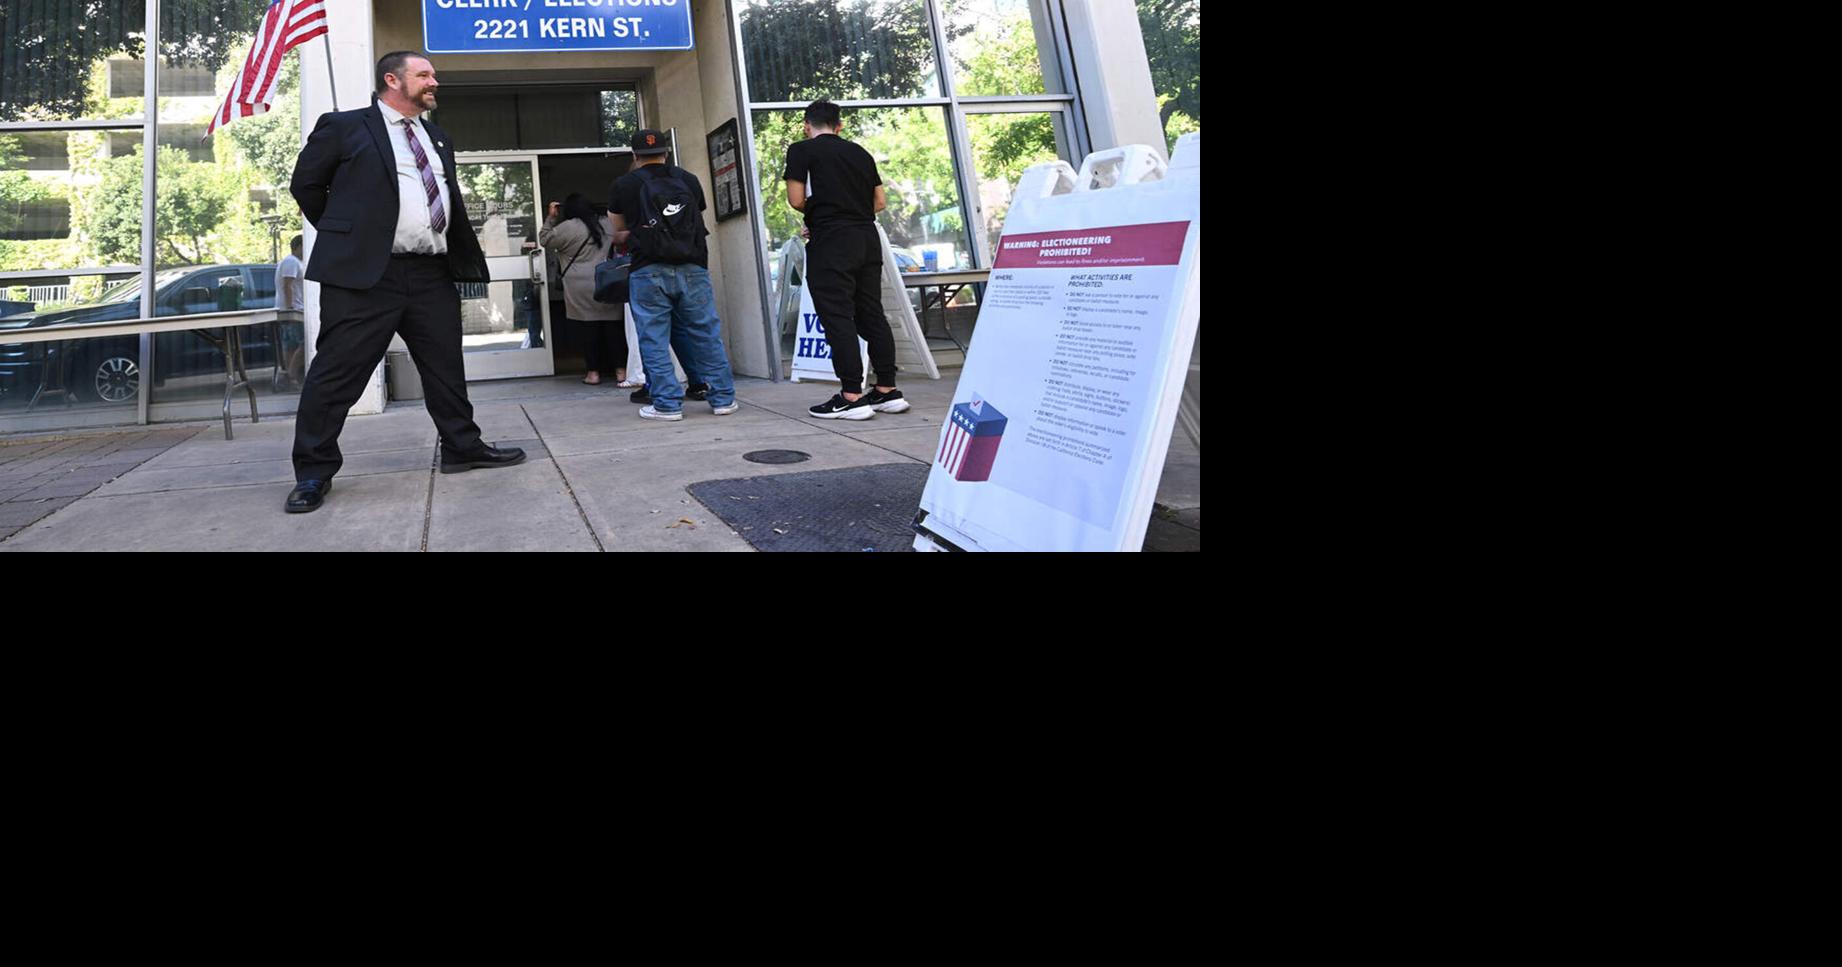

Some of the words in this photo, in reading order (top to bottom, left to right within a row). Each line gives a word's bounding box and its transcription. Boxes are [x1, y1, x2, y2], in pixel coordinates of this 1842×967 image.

[474, 19, 528, 38] 2221
[539, 18, 605, 38] KERN
[613, 16, 650, 37] ST.
[1003, 240, 1040, 250] WARNING:
[1041, 235, 1112, 247] ELECTIONEERING
[1039, 247, 1092, 257] PROHIBITED!
[797, 337, 833, 359] HE
